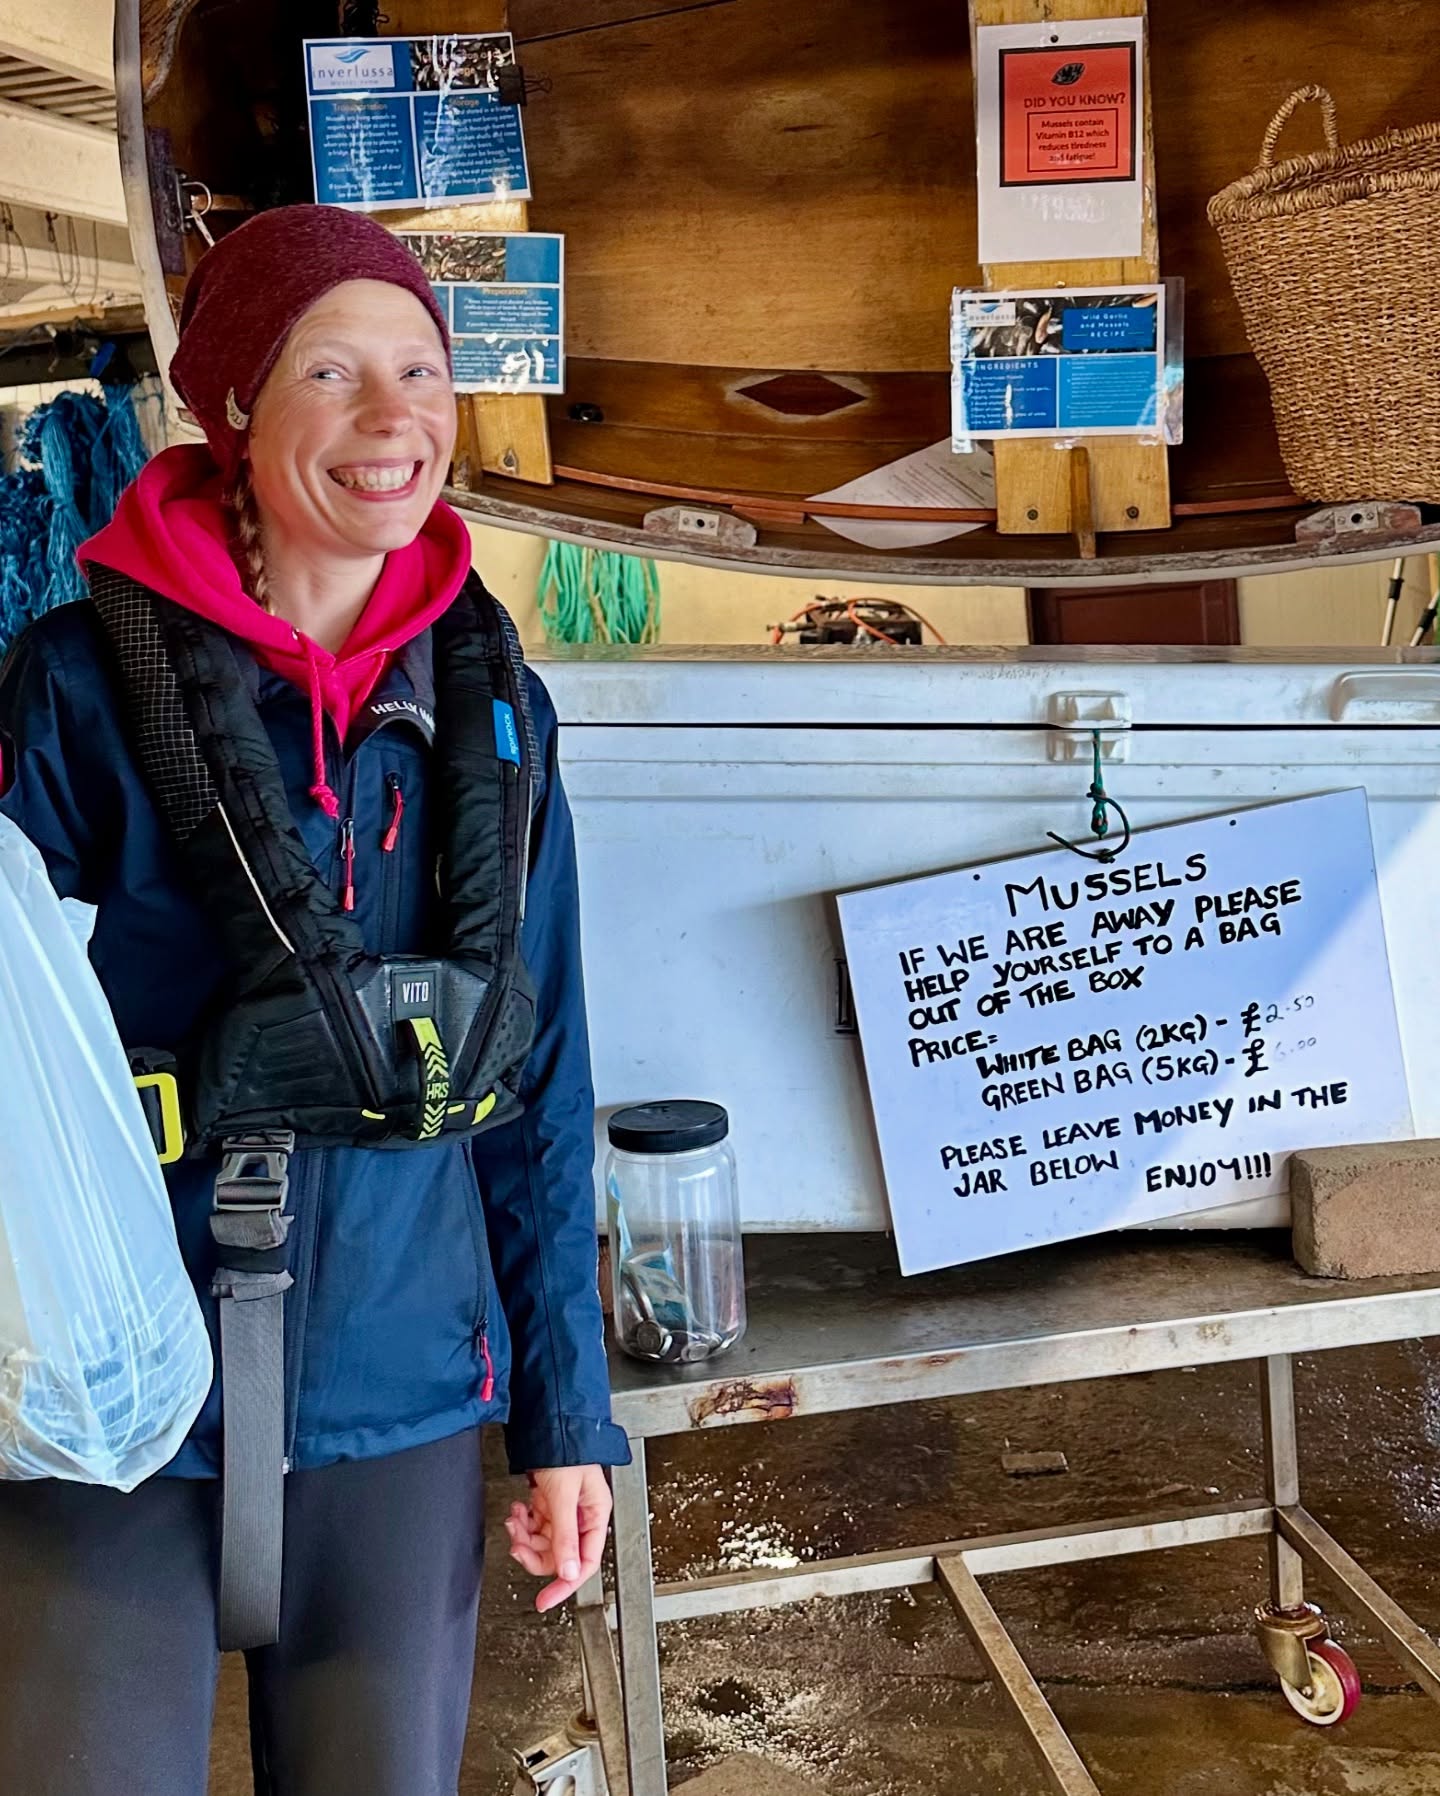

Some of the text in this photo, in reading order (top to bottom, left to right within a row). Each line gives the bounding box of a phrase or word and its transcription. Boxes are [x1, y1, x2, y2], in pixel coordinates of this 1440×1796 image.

[1024, 92, 1126, 109] DID YOU KNOW?
[1036, 128, 1110, 140] Vitamin B12 which
[1041, 118, 1104, 128] Mussels contain
[1038, 141, 1107, 152] reduces tiredness
[1103, 312, 1128, 320] Garlic
[1090, 330, 1125, 338] RECIPE
[977, 361, 1039, 371] INGREDIENTS
[371, 700, 418, 715] HELLY
[504, 713, 519, 755] spinlock
[1004, 853, 1207, 918] MUSSELS
[899, 880, 1301, 976] IF WE ARE AWAY PLEASE
[904, 912, 1281, 1003] HELP YOURSELF TO A BAG
[402, 981, 429, 1004] VITO
[908, 965, 1145, 1030] OUT OF THE BOX
[976, 1044, 1060, 1079] WHITE
[1067, 1029, 1122, 1062] BAG
[1136, 1013, 1208, 1052] (2KG)
[426, 1081, 450, 1100] HRS
[981, 1071, 1065, 1112] GREEN
[1074, 1061, 1133, 1094] BAG
[1142, 1048, 1218, 1085] (5KG)
[940, 1081, 1348, 1170] PLEASE LEAVE MONEY IN THE
[953, 1149, 1272, 1198] JAR BELOW ENJOY!!!
